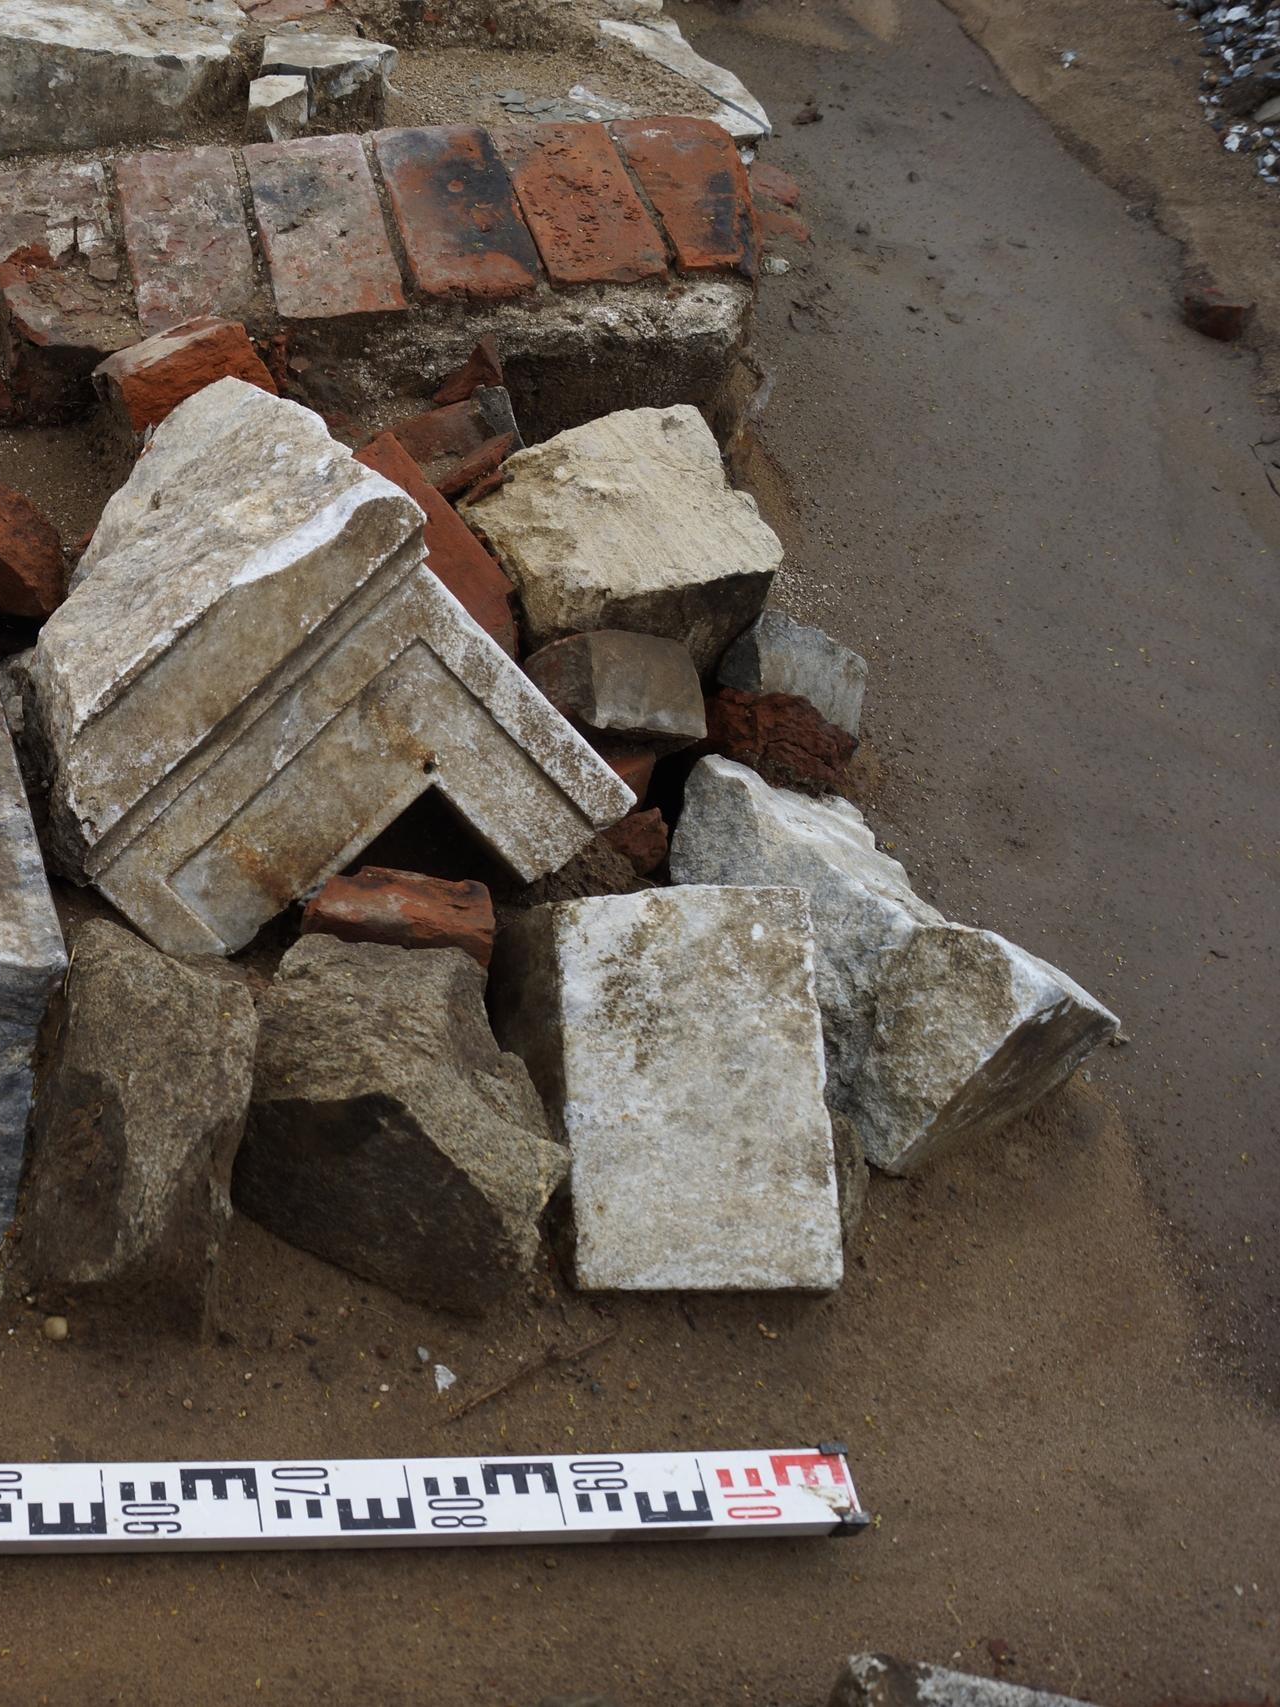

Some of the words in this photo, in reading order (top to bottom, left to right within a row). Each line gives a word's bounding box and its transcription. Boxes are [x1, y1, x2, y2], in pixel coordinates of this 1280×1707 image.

[271, 1465, 329, 1497] 07
[569, 1461, 627, 1493] 09
[122, 1502, 181, 1534] 06
[429, 1496, 487, 1528] 08
[723, 1487, 780, 1520] 10
